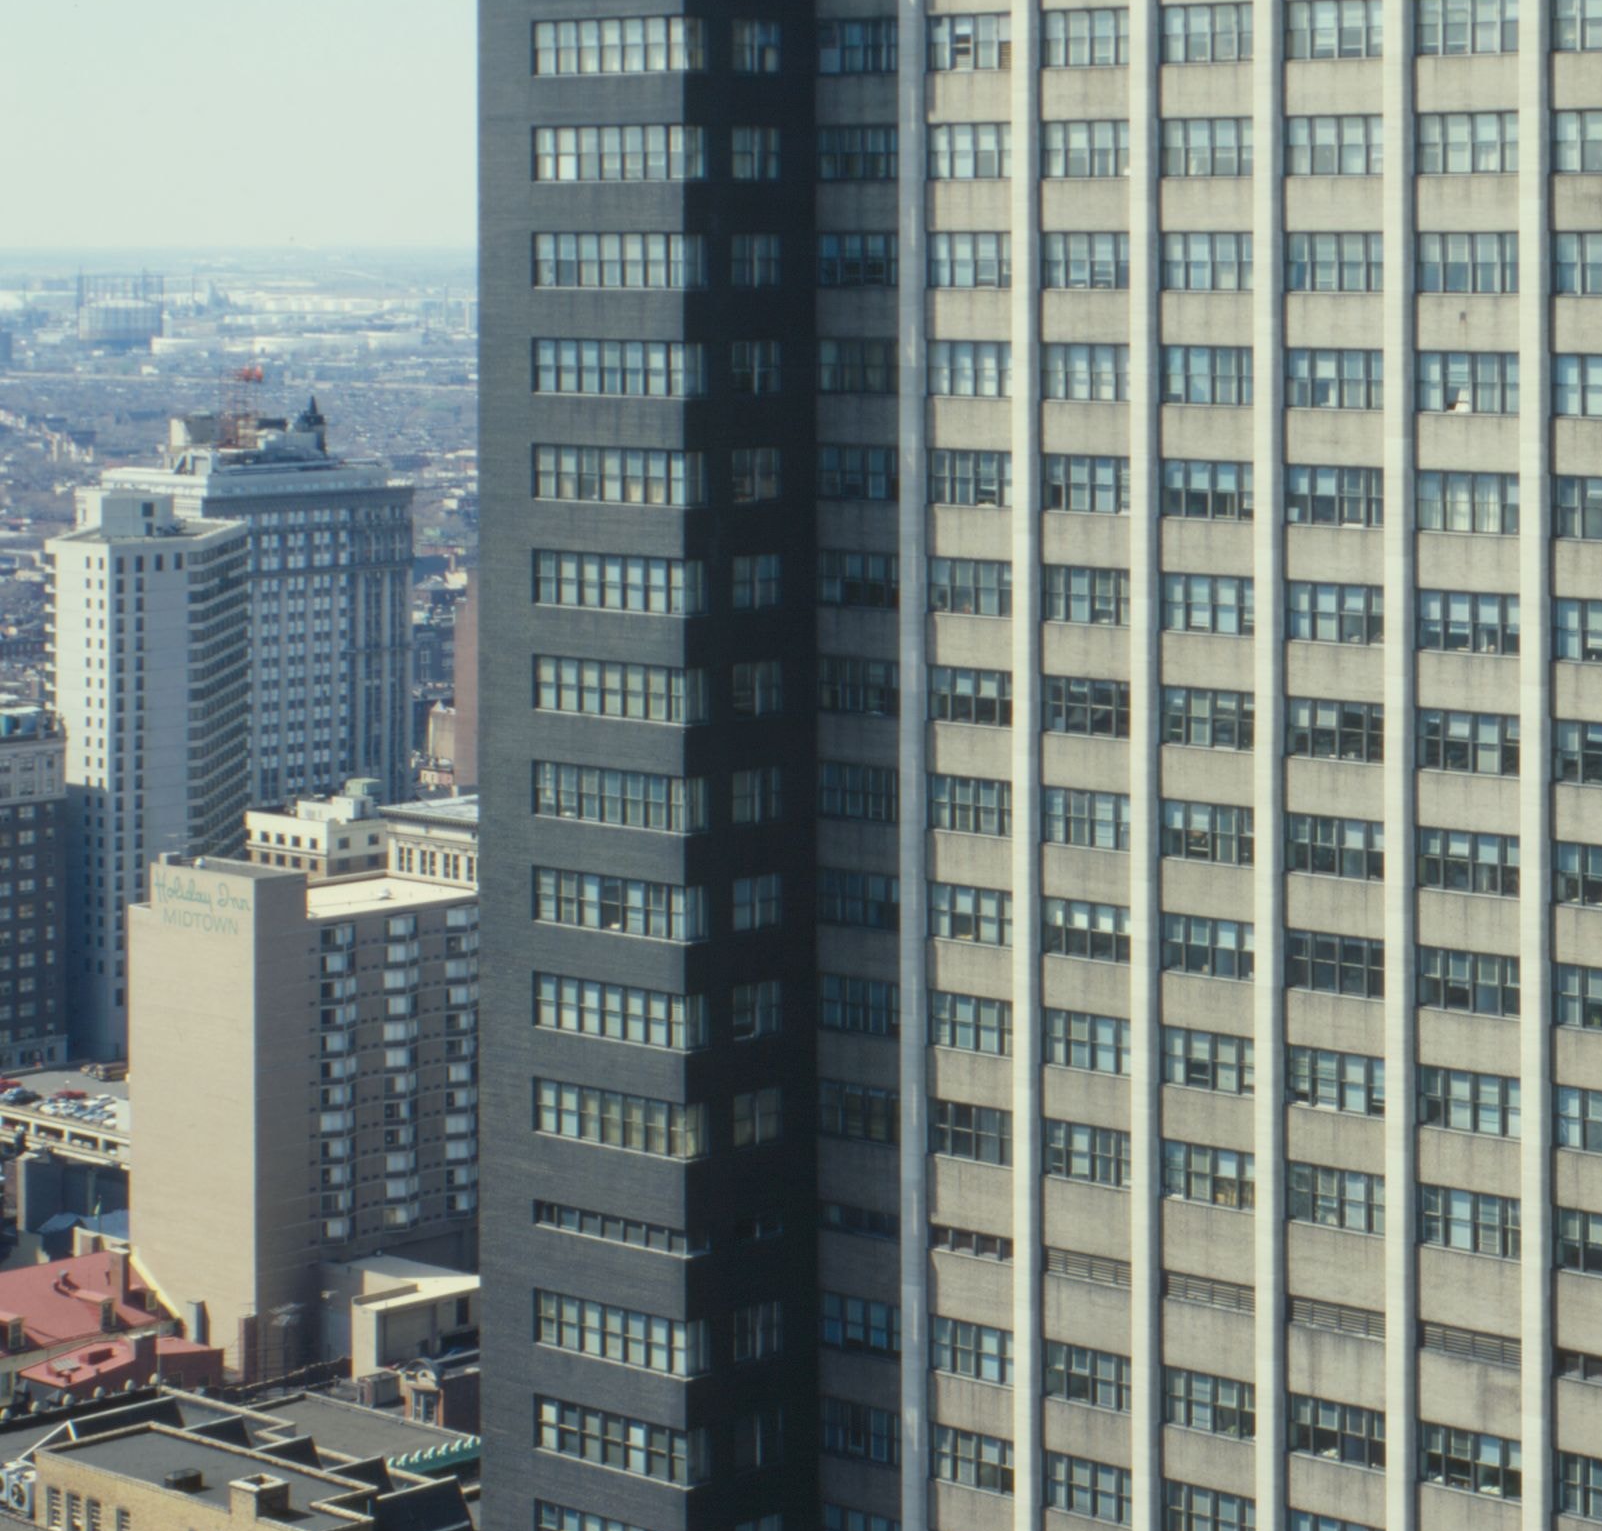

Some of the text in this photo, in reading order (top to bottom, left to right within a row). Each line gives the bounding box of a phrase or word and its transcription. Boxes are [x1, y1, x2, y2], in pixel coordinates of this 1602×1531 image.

[154, 869, 251, 917] Holiday Inn
[163, 908, 239, 935] MIDTOWN
